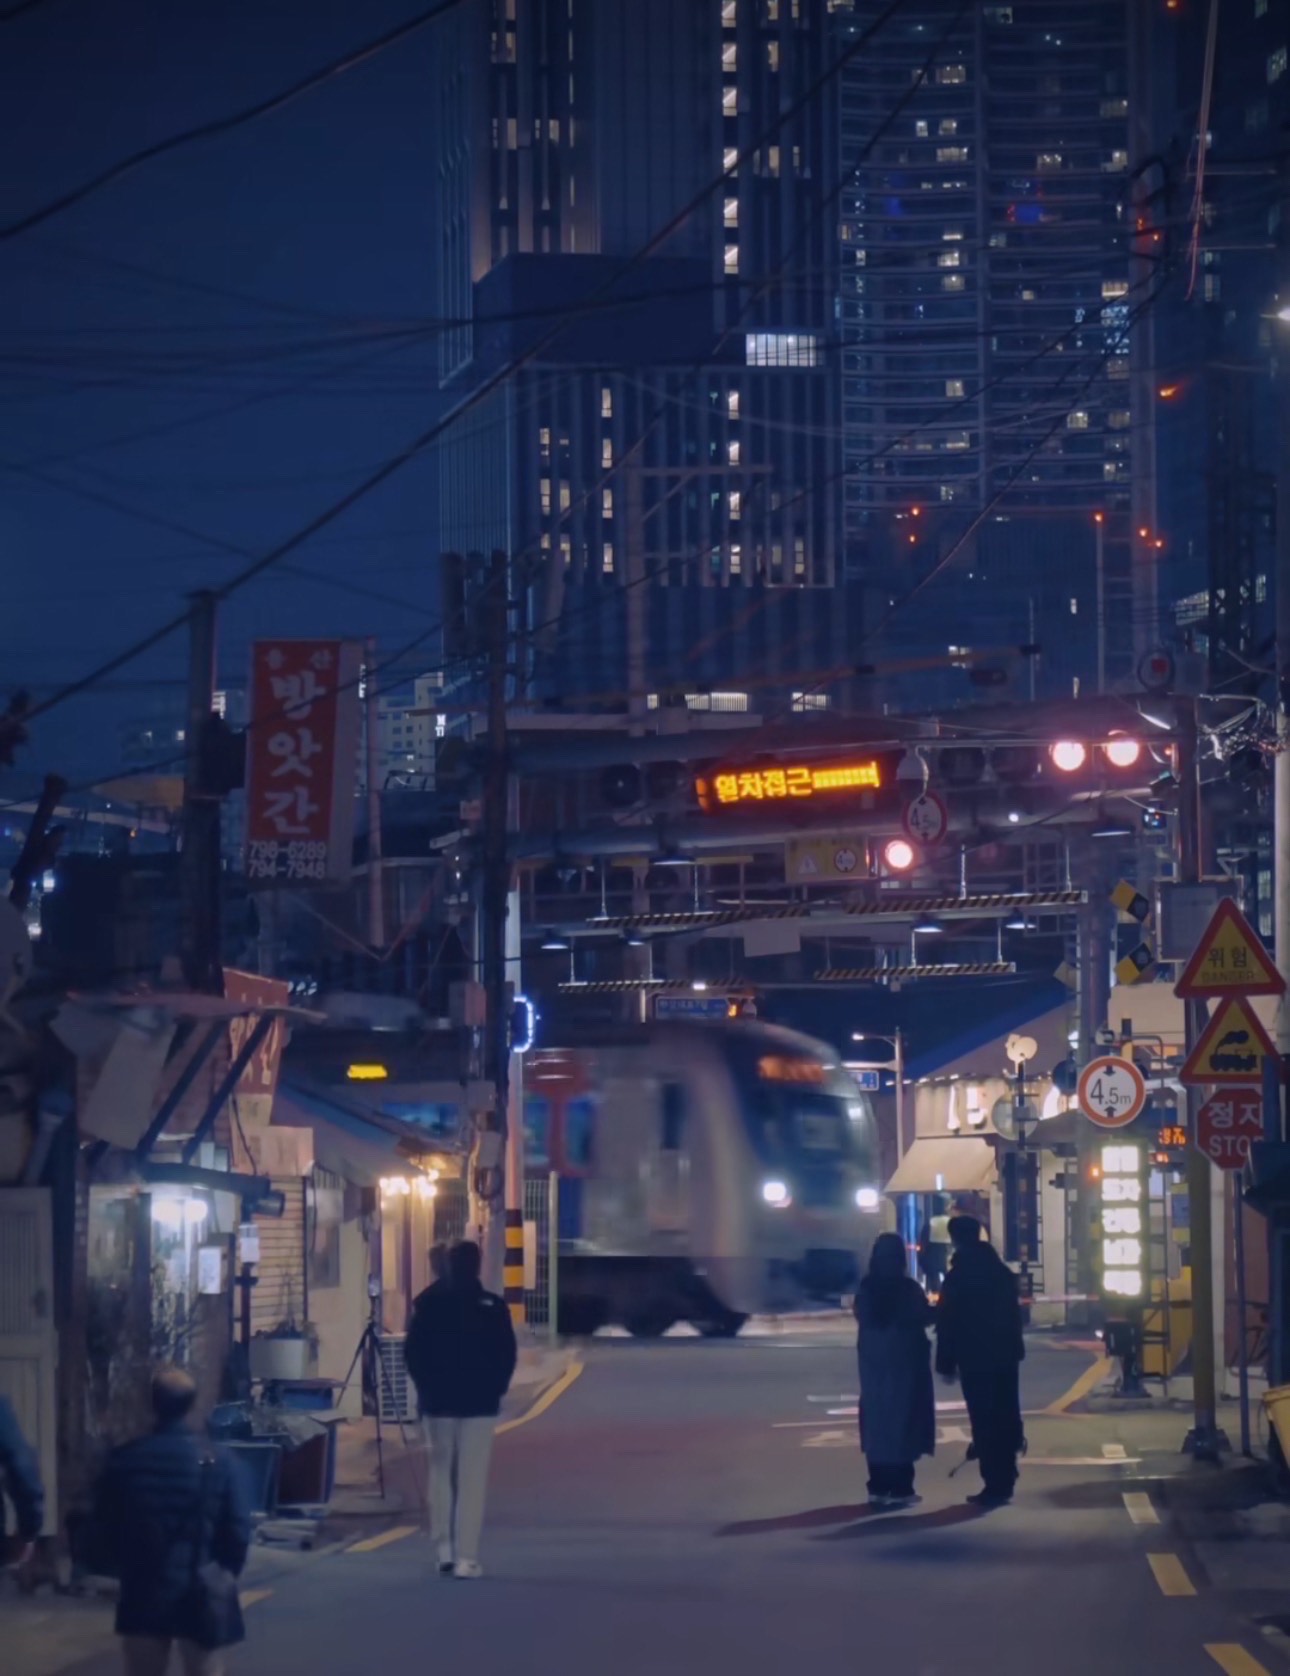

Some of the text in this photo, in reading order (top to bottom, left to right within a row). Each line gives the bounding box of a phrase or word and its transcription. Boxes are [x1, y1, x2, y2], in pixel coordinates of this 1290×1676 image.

[262, 670, 326, 834] 방앗간
[714, 766, 813, 803] 열차접근
[249, 841, 326, 860] 798-6289
[248, 860, 325, 879] 794-7948
[1207, 946, 1247, 968] 위험
[1090, 1078, 1132, 1105] 4.5m
[1208, 1101, 1264, 1129] 정지
